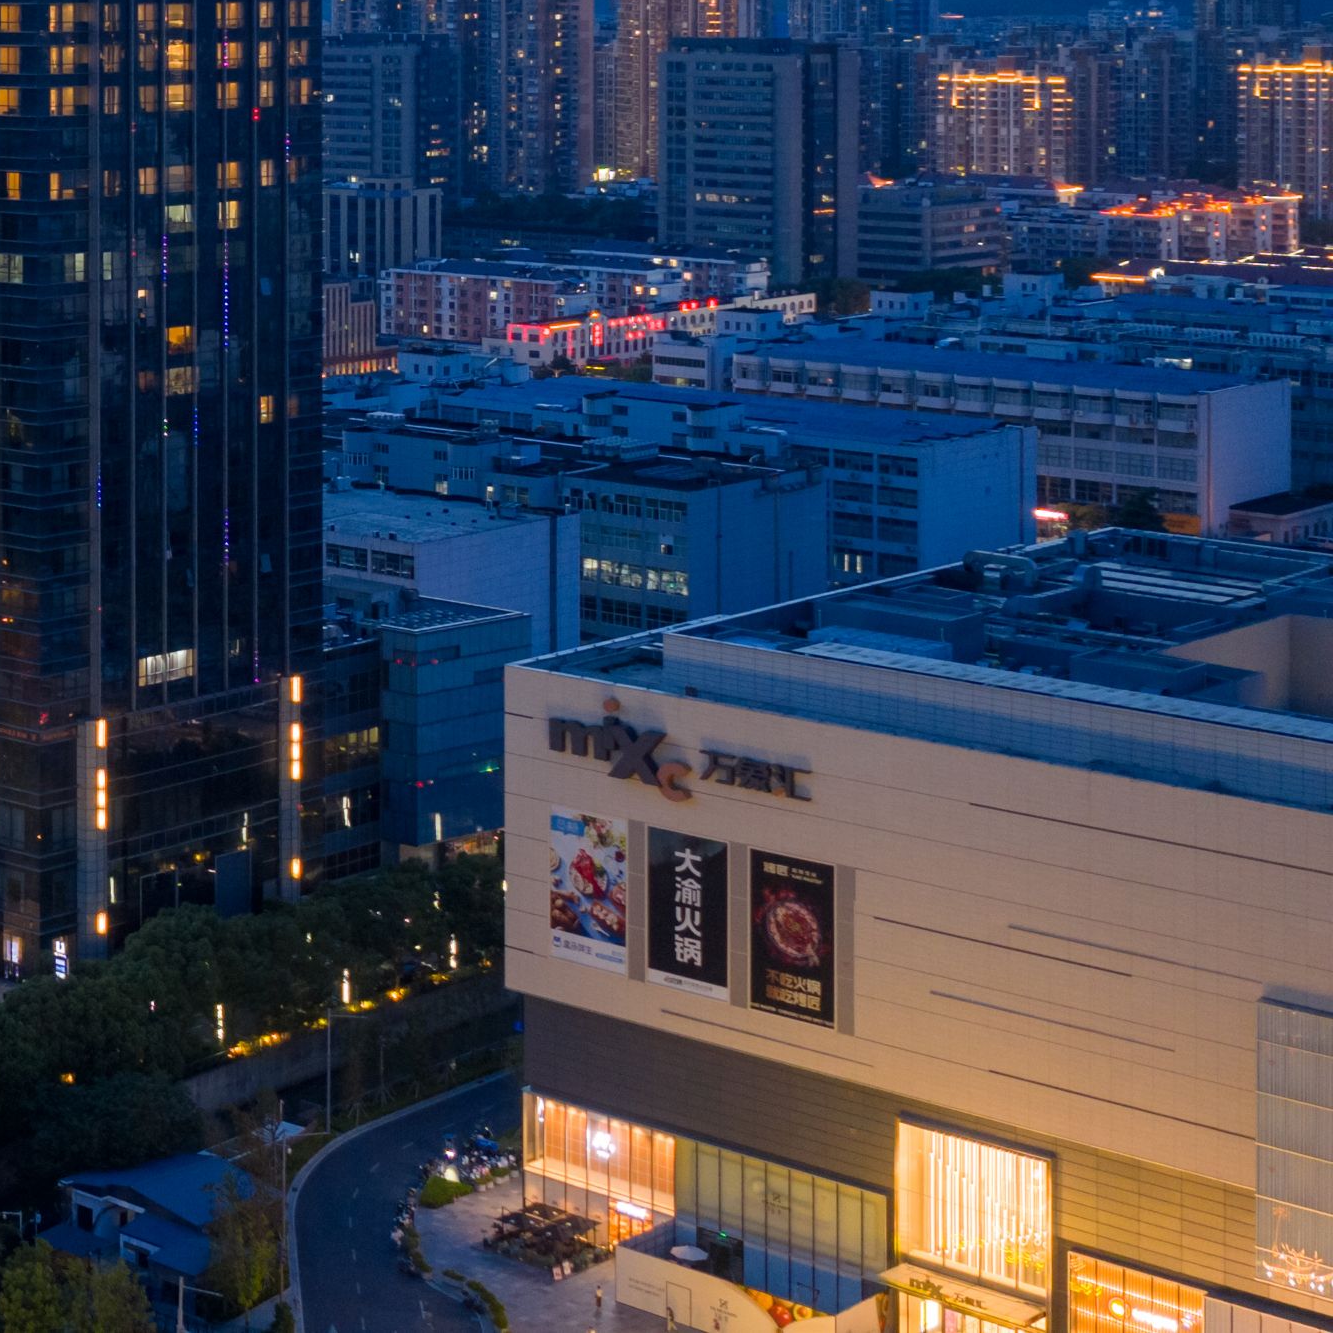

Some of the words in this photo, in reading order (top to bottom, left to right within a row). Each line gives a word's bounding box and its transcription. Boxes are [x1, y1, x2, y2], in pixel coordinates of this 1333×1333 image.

[699, 749, 813, 802] 万象汇
[674, 848, 702, 967] 大渝火锅
